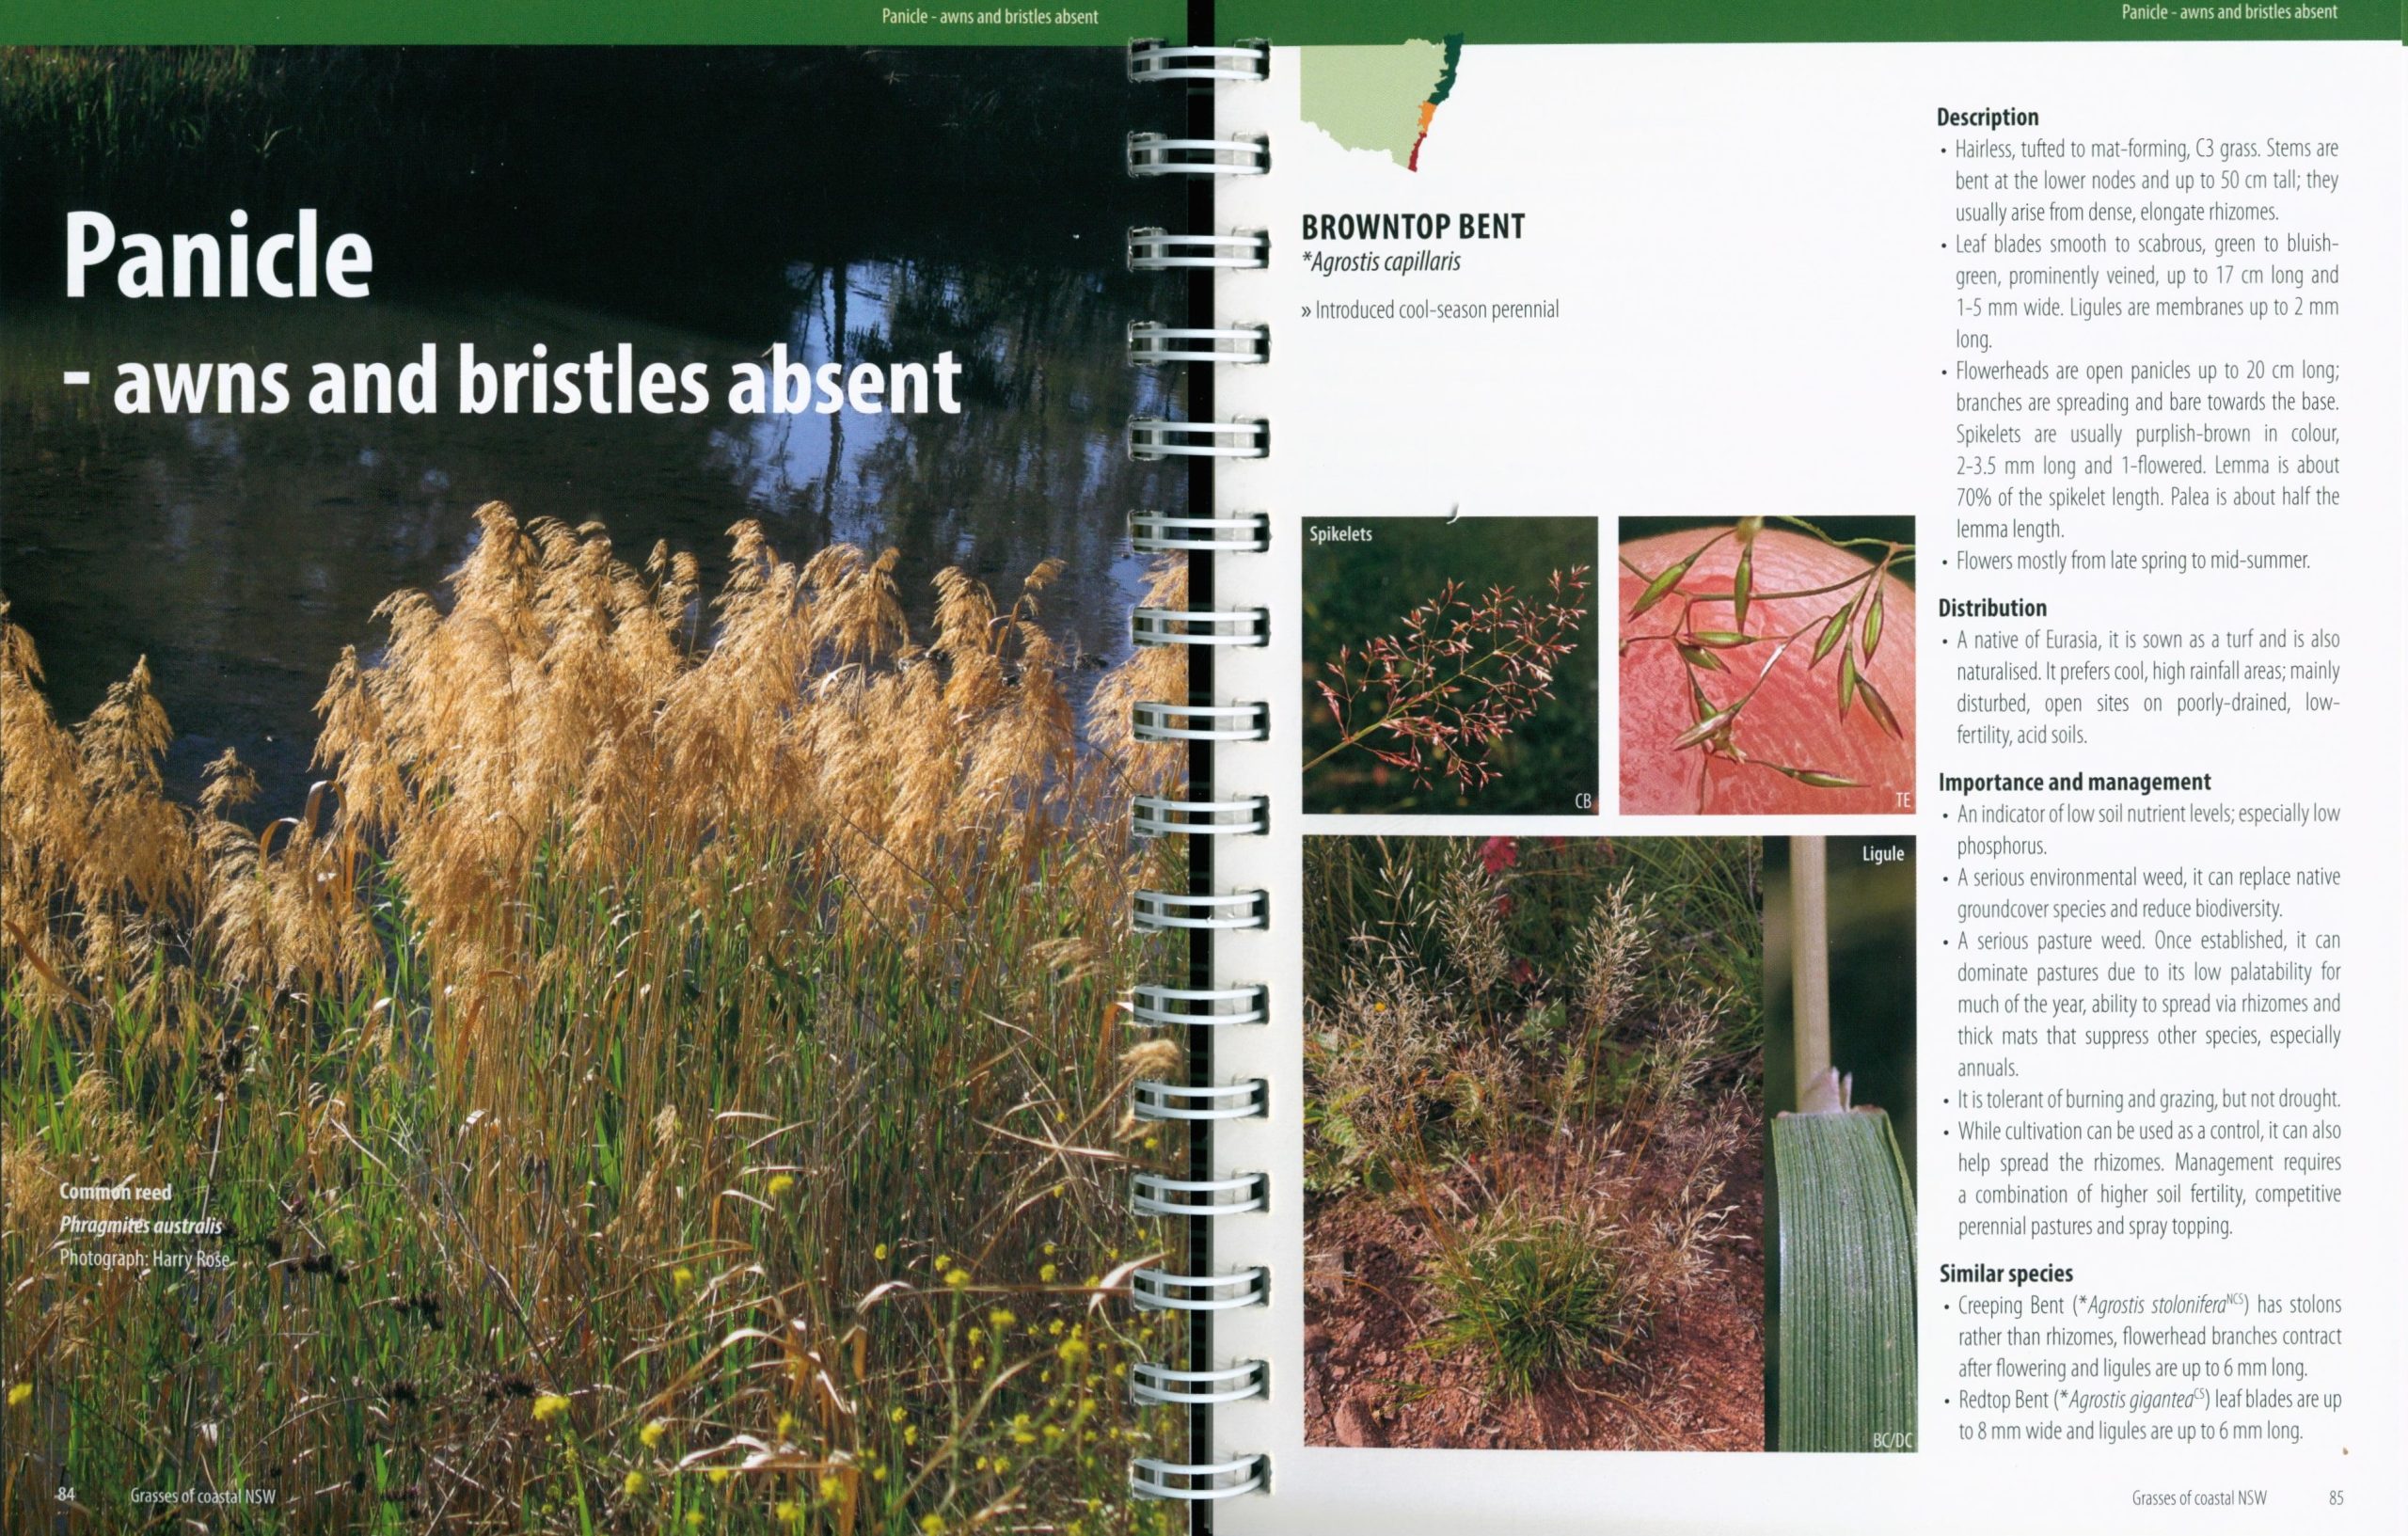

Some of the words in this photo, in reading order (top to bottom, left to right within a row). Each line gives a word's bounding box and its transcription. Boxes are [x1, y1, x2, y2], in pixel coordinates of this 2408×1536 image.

[882, 8, 928, 24] Panicle
[940, 11, 974, 24] awns
[976, 8, 1002, 24] and
[1005, 8, 1053, 24] bristles
[1054, 8, 1100, 24] absent
[2122, 3, 2168, 20] Panicle
[2179, 7, 2215, 20] awns
[2217, 3, 2242, 20] and
[2245, 3, 2292, 20] bristles
[2294, 3, 2338, 20] absent
[1937, 106, 2039, 132] Description
[1956, 138, 2016, 161] Hairless,
[2020, 137, 2065, 158] tufted
[2070, 141, 2085, 158] to
[2091, 137, 2191, 163] mat-forming,
[2195, 137, 2214, 158] C3
[2220, 142, 2261, 163] grass.
[2267, 137, 2311, 157] Stems
[2316, 142, 2339, 157] are
[1302, 213, 1451, 241] BROWNTOP
[1459, 213, 1526, 240] BENT
[67, 208, 372, 298] Panicle
[1956, 232, 1988, 254] Leaf
[1994, 232, 2042, 253] blades
[2050, 232, 2106, 253] smooth
[2115, 236, 2131, 253] to
[2138, 232, 2206, 256] scabrous,
[2214, 237, 2256, 258] green
[2263, 235, 2279, 253] to
[2288, 232, 2339, 252] bluish-
[1384, 249, 1462, 277] capillaris
[1316, 298, 1395, 320] Introduced
[1399, 298, 1487, 319] cool-season
[1492, 298, 1560, 324] perennial
[114, 362, 290, 414] awns
[309, 342, 436, 414] and
[460, 342, 709, 414] bristles
[728, 342, 962, 415] absent
[1956, 391, 2022, 412] branches
[2028, 396, 2051, 412] are
[2056, 391, 2129, 417] spreading
[2135, 390, 2163, 411] and
[2169, 390, 2202, 412] bare
[2207, 390, 2266, 411] towards
[2272, 390, 2296, 411] the
[2302, 390, 2339, 411] base.
[1956, 423, 2021, 449] Spikelets
[2034, 428, 2057, 443] are
[2070, 422, 2123, 448] usually
[2136, 422, 2251, 448] purplish-brown
[2264, 423, 2277, 442] in
[2291, 421, 2339, 445] colour,
[1956, 487, 1992, 507] 70%
[1998, 486, 2014, 507] of
[2018, 486, 2043, 506] the
[2049, 486, 2106, 512] spikelet
[2112, 486, 2163, 512] length.
[2171, 486, 2210, 506] Palea
[2216, 487, 2227, 506] is
[2233, 485, 2276, 506] about
[2282, 484, 2311, 506] half
[2315, 485, 2340, 506] the
[1309, 525, 1372, 546] Spikelets
[1957, 550, 2013, 570] Flowers
[2018, 549, 2067, 575] mostly
[2070, 549, 2106, 570] from
[2111, 549, 2138, 570] late
[2141, 550, 2187, 575] spring
[2191, 552, 2207, 569] to
[2210, 548, 2310, 569] mid-summer.
[1939, 596, 2048, 618] Distribution
[1956, 692, 2031, 715] disturbed,
[2045, 697, 2083, 717] open
[2097, 693, 2130, 712] sites
[2144, 697, 2162, 712] on
[2178, 691, 2290, 717] poorly-drained,
[2305, 691, 2340, 712] low-
[1939, 771, 2045, 797] Importance
[2048, 770, 2083, 792] and
[2088, 772, 2212, 797] management
[1576, 793, 1592, 809] CB
[1895, 792, 1910, 808] TE
[1957, 803, 1977, 823] An
[1982, 803, 2046, 824] indicator
[2049, 802, 2065, 823] of
[2067, 803, 2095, 823] low
[2099, 803, 2123, 823] soil
[2128, 804, 2186, 823] nutrient
[2190, 802, 2235, 825] levels;
[2239, 802, 2310, 828] especially
[2314, 802, 2341, 822] low
[1862, 845, 1905, 865] Ligule
[1957, 867, 1969, 887] A
[1973, 868, 2025, 887] serious
[2030, 866, 2137, 887] environmental
[2143, 866, 2187, 889] weed,
[2194, 869, 2203, 886] it
[2208, 871, 2233, 886] can
[2239, 865, 2291, 891] replace
[2296, 866, 2341, 886] native
[1957, 962, 2028, 982] dominate
[2036, 965, 2099, 987] pastures
[2107, 961, 2135, 982] due
[2144, 964, 2159, 982] to
[2168, 962, 2185, 981] its
[2194, 960, 2222, 981] low
[2230, 960, 2312, 986] palatability
[2321, 960, 2341, 981] for
[59, 1181, 131, 1201] Common
[135, 1182, 173, 1202] reed
[59, 1214, 151, 1238] Phragmites
[153, 1217, 223, 1236] australis
[59, 1248, 150, 1272] Photograph:
[152, 1250, 194, 1271] Harry
[196, 1249, 231, 1269] Rose
[1940, 1262, 2005, 1284] Similar
[2007, 1262, 2074, 1288] species
[1958, 1294, 2022, 1320] Creeping
[2031, 1294, 2065, 1315] Bent
[2258, 1293, 2283, 1314] has
[2289, 1293, 2342, 1314] stolons
[1959, 1326, 2003, 1346] rather
[2006, 1326, 2040, 1346] than
[2046, 1325, 2117, 1348] rhizomes,
[2122, 1325, 2206, 1346] flowerhead
[2211, 1325, 2278, 1345] branches
[2282, 1328, 2342, 1345] contract
[1959, 1389, 2011, 1414] Redtop
[2015, 1388, 2050, 1409] Bent
[2215, 1387, 2243, 1408] leaf
[2245, 1388, 2293, 1408] blades
[2296, 1393, 2320, 1408] are
[2323, 1393, 2342, 1413] up
[1873, 1432, 1913, 1449] BC/DC
[56, 1485, 76, 1502] 84
[130, 1486, 180, 1504] Grasses
[181, 1487, 197, 1504] of
[197, 1487, 243, 1505] coastal
[245, 1488, 277, 1505] NSW
[2132, 1489, 2177, 1506] Grasses
[2179, 1489, 2193, 1506] of
[2194, 1490, 2235, 1506] coastal
[2238, 1489, 2268, 1506] NSW
[2329, 1490, 2344, 1506] 85
